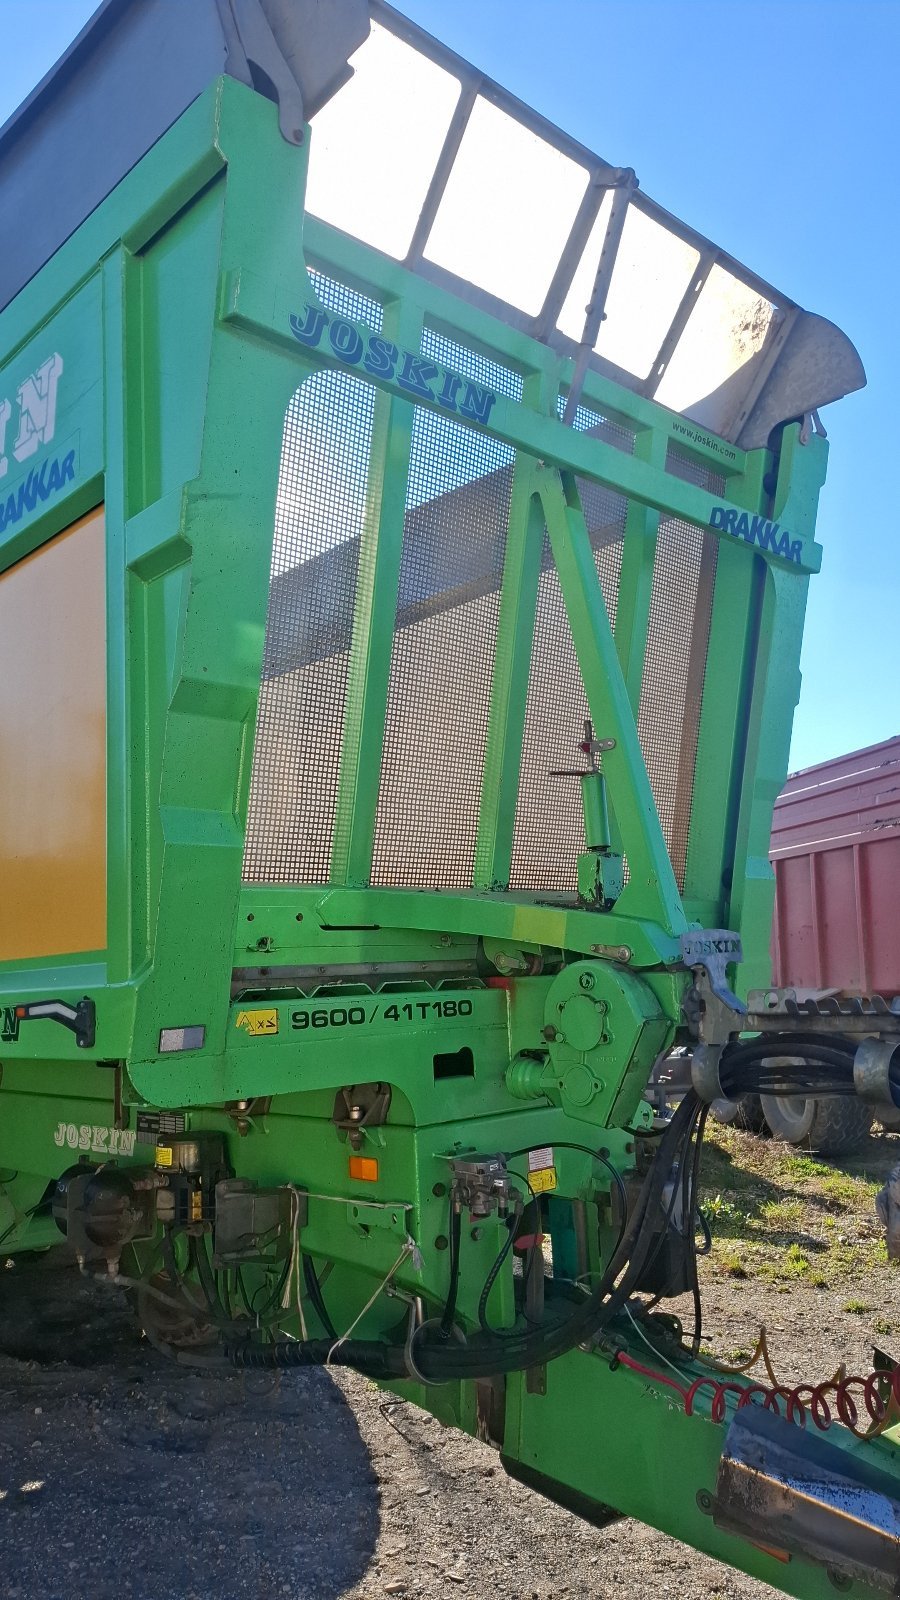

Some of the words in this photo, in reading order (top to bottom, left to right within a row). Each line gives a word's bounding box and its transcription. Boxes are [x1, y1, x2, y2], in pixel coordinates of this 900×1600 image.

[288, 304, 496, 426] JOSKIN
[672, 421, 736, 460] www.joskin.com
[709, 507, 802, 564] DRAKKAR
[684, 940, 740, 955] JOSKIN
[54, 1122, 136, 1156] JOSKIN
